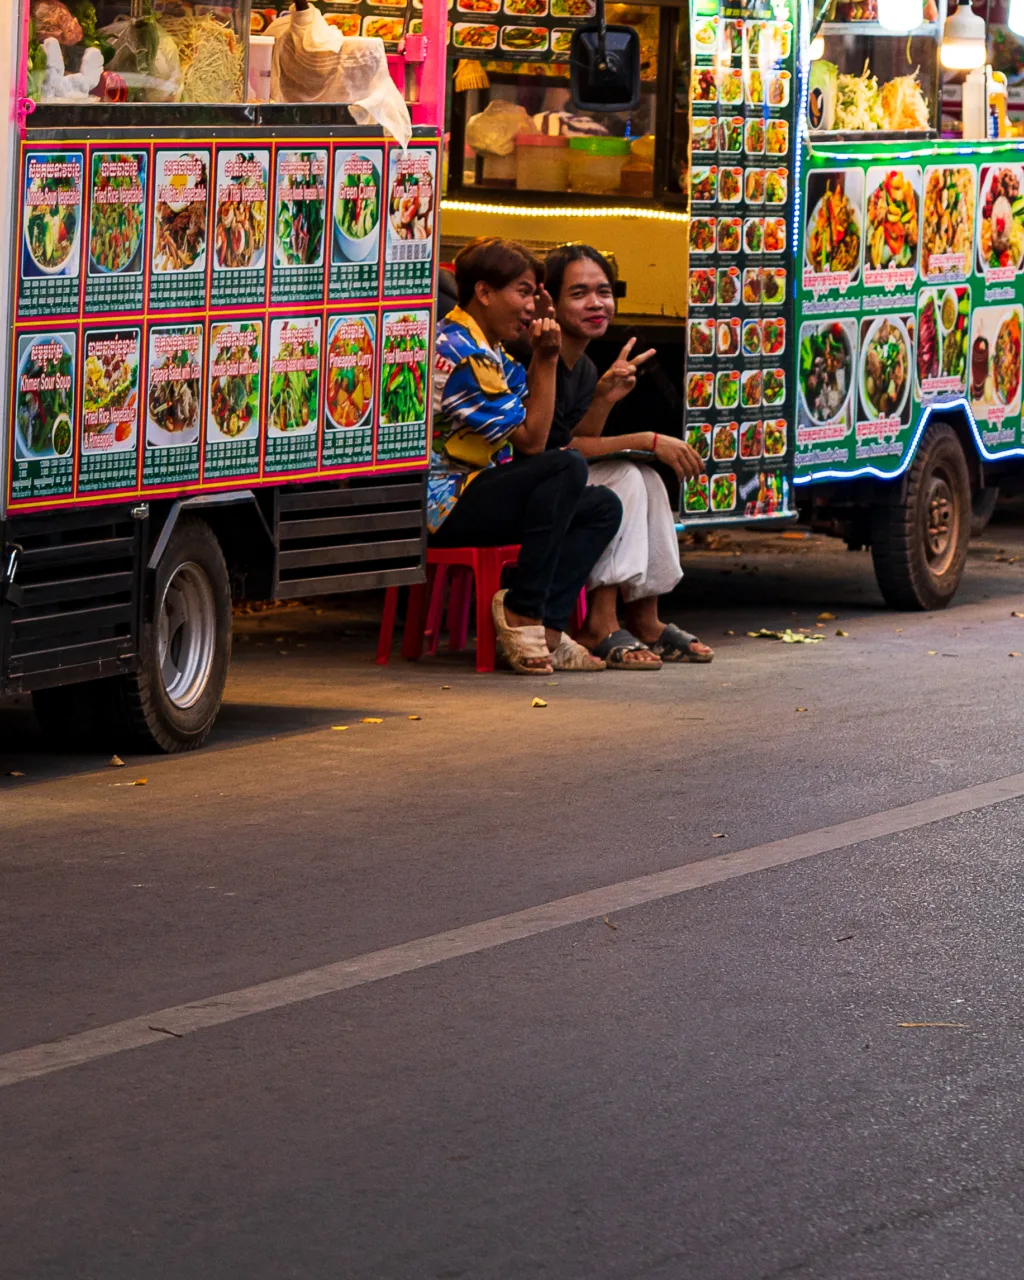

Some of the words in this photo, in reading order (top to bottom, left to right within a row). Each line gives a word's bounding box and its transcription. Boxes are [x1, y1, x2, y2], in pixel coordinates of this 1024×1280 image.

[26, 188, 45, 206] Noodle
[45, 187, 56, 209] Soup
[58, 187, 80, 209] Vegetable
[94, 186, 108, 203] Fried
[108, 186, 119, 203] Rice
[120, 186, 143, 207] Vegetable
[181, 184, 206, 206] Vegetable
[218, 184, 230, 202] Pad
[230, 184, 242, 202] Thai
[242, 184, 266, 206] Vegetable
[339, 181, 358, 200] Green
[358, 182, 376, 204] Curry
[329, 352, 357, 370] Pineapple
[357, 351, 372, 369] Curry
[20, 375, 40, 392] Khmer
[40, 373, 55, 391] Sour
[55, 372, 72, 392] Soup
[150, 365, 168, 385] Papaya
[168, 364, 182, 381] Salad
[84, 409, 99, 425] Fried
[99, 408, 110, 424] Rice
[110, 406, 136, 426] Vegetable
[84, 432, 89, 449] &
[89, 432, 114, 450] Pineapple
